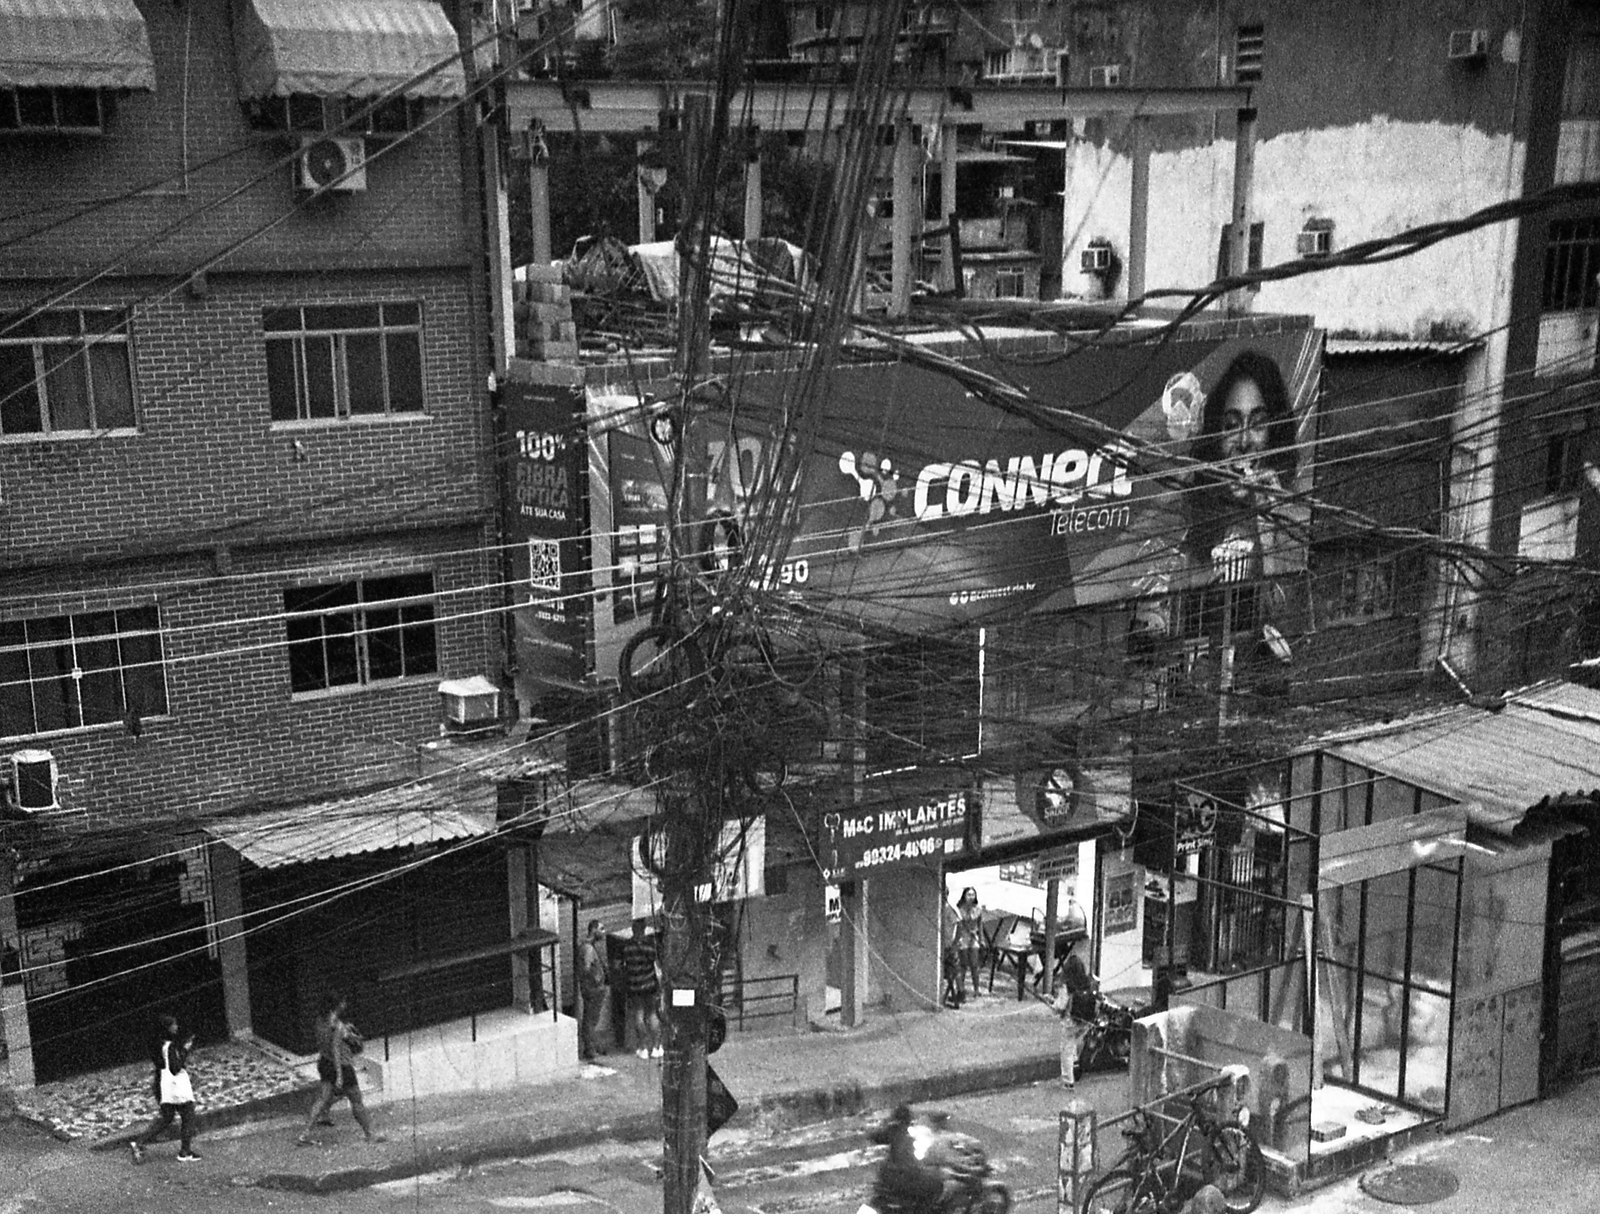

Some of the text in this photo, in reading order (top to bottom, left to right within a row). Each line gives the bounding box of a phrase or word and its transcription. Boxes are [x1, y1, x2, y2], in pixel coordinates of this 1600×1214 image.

[516, 430, 566, 460] 100%
[516, 462, 568, 489] FIBRA
[1050, 505, 1130, 536] Telecom
[843, 815, 874, 838] M&C
[878, 797, 966, 832] IMPLANTES
